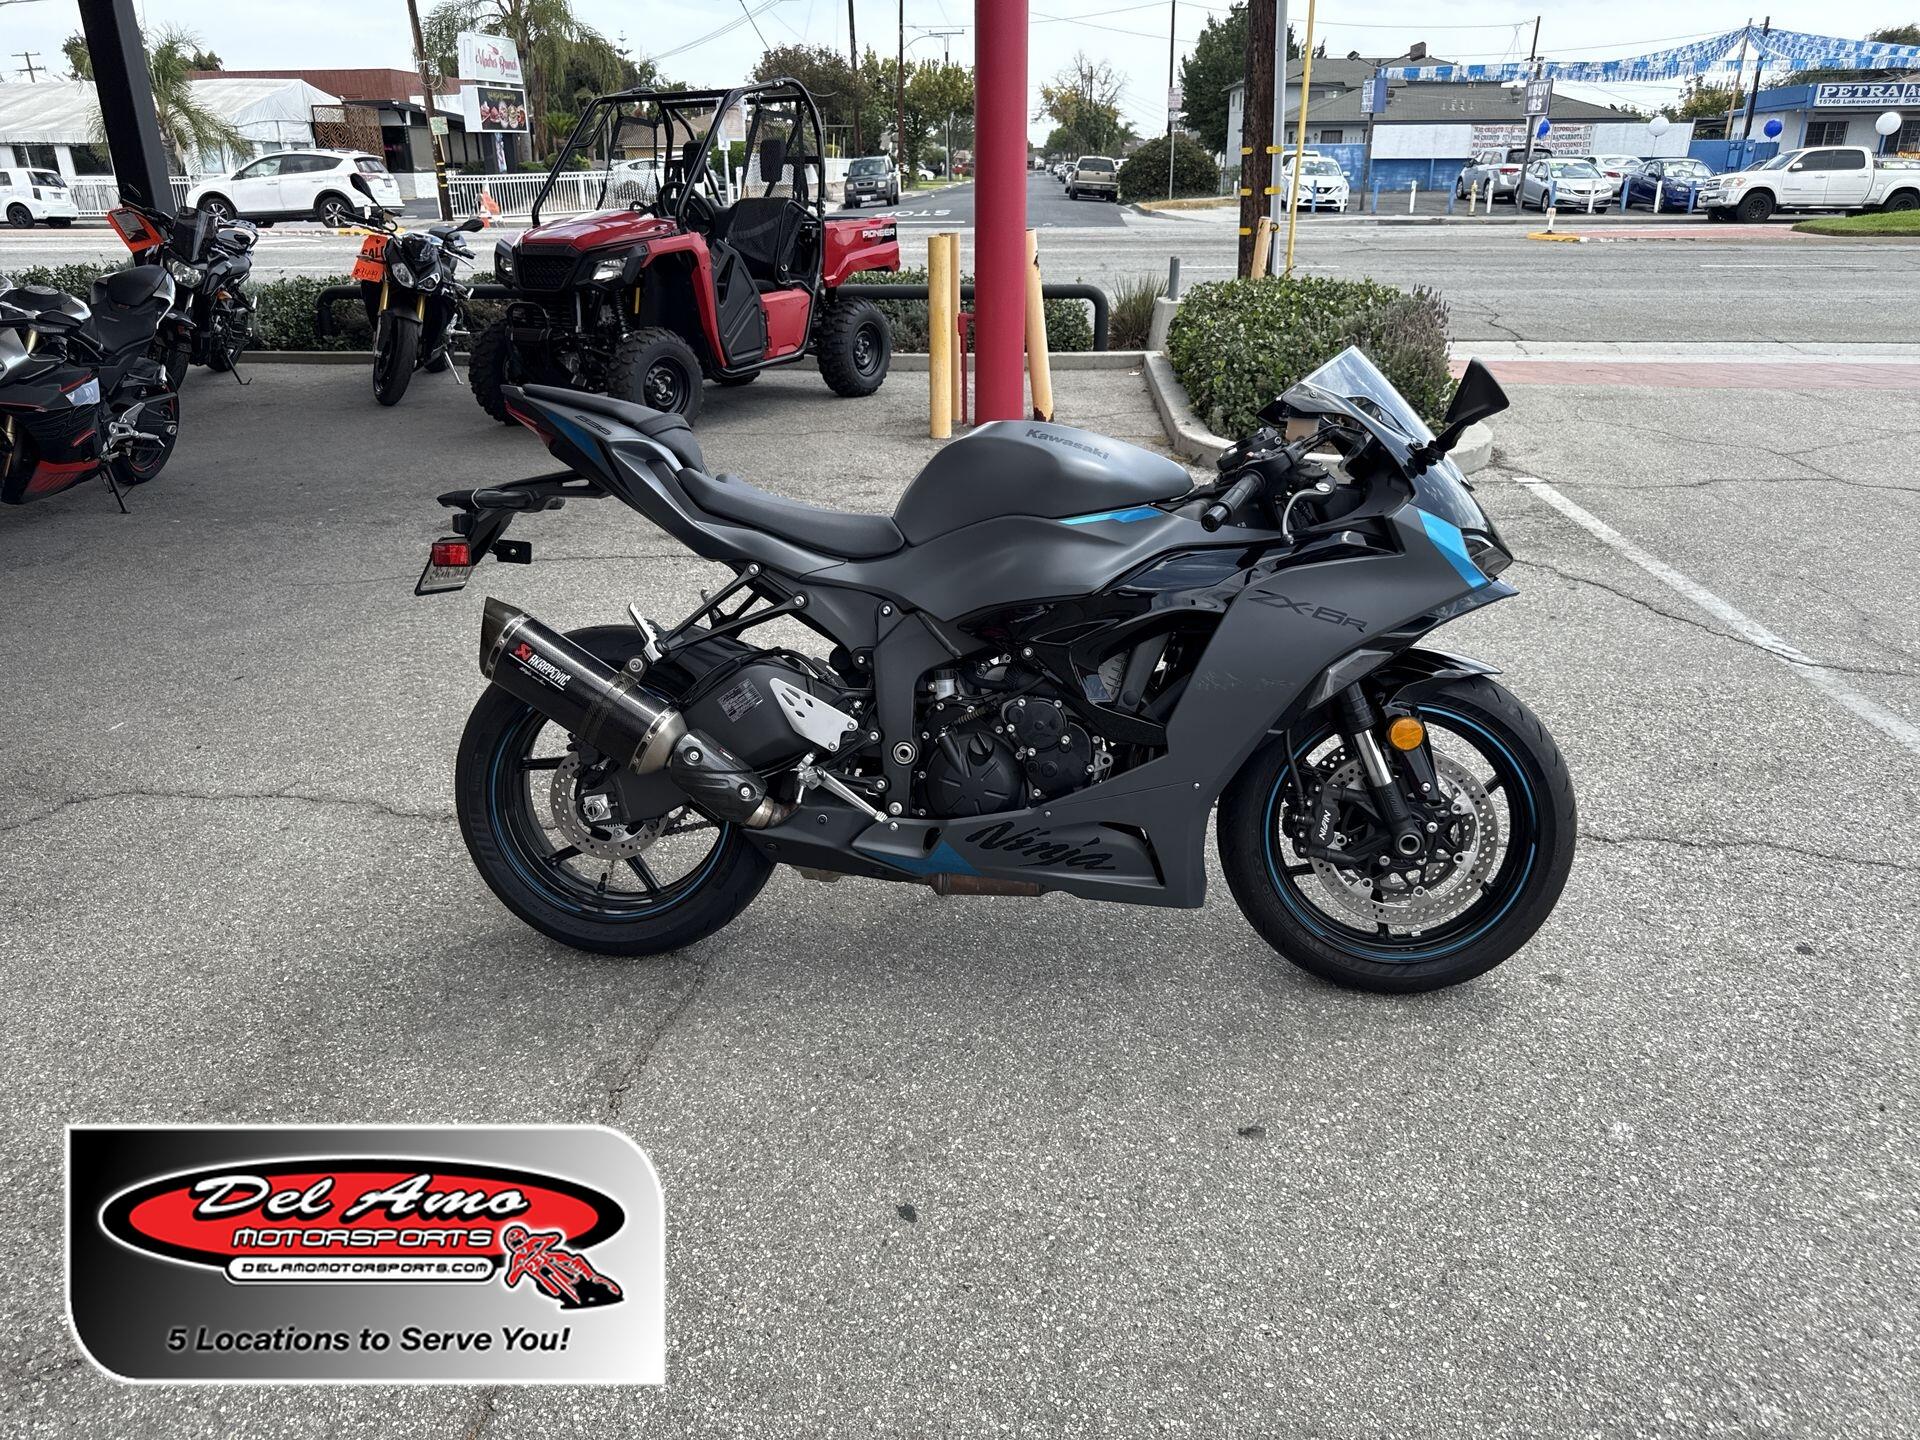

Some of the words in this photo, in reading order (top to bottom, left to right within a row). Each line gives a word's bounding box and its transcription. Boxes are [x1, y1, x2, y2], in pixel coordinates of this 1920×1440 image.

[1821, 86, 1900, 98] PETRA
[862, 228, 895, 239] PIONEER
[1025, 428, 1110, 461] Kawasaki
[1247, 589, 1368, 633] ZX-6R
[965, 821, 1116, 870] Ninja
